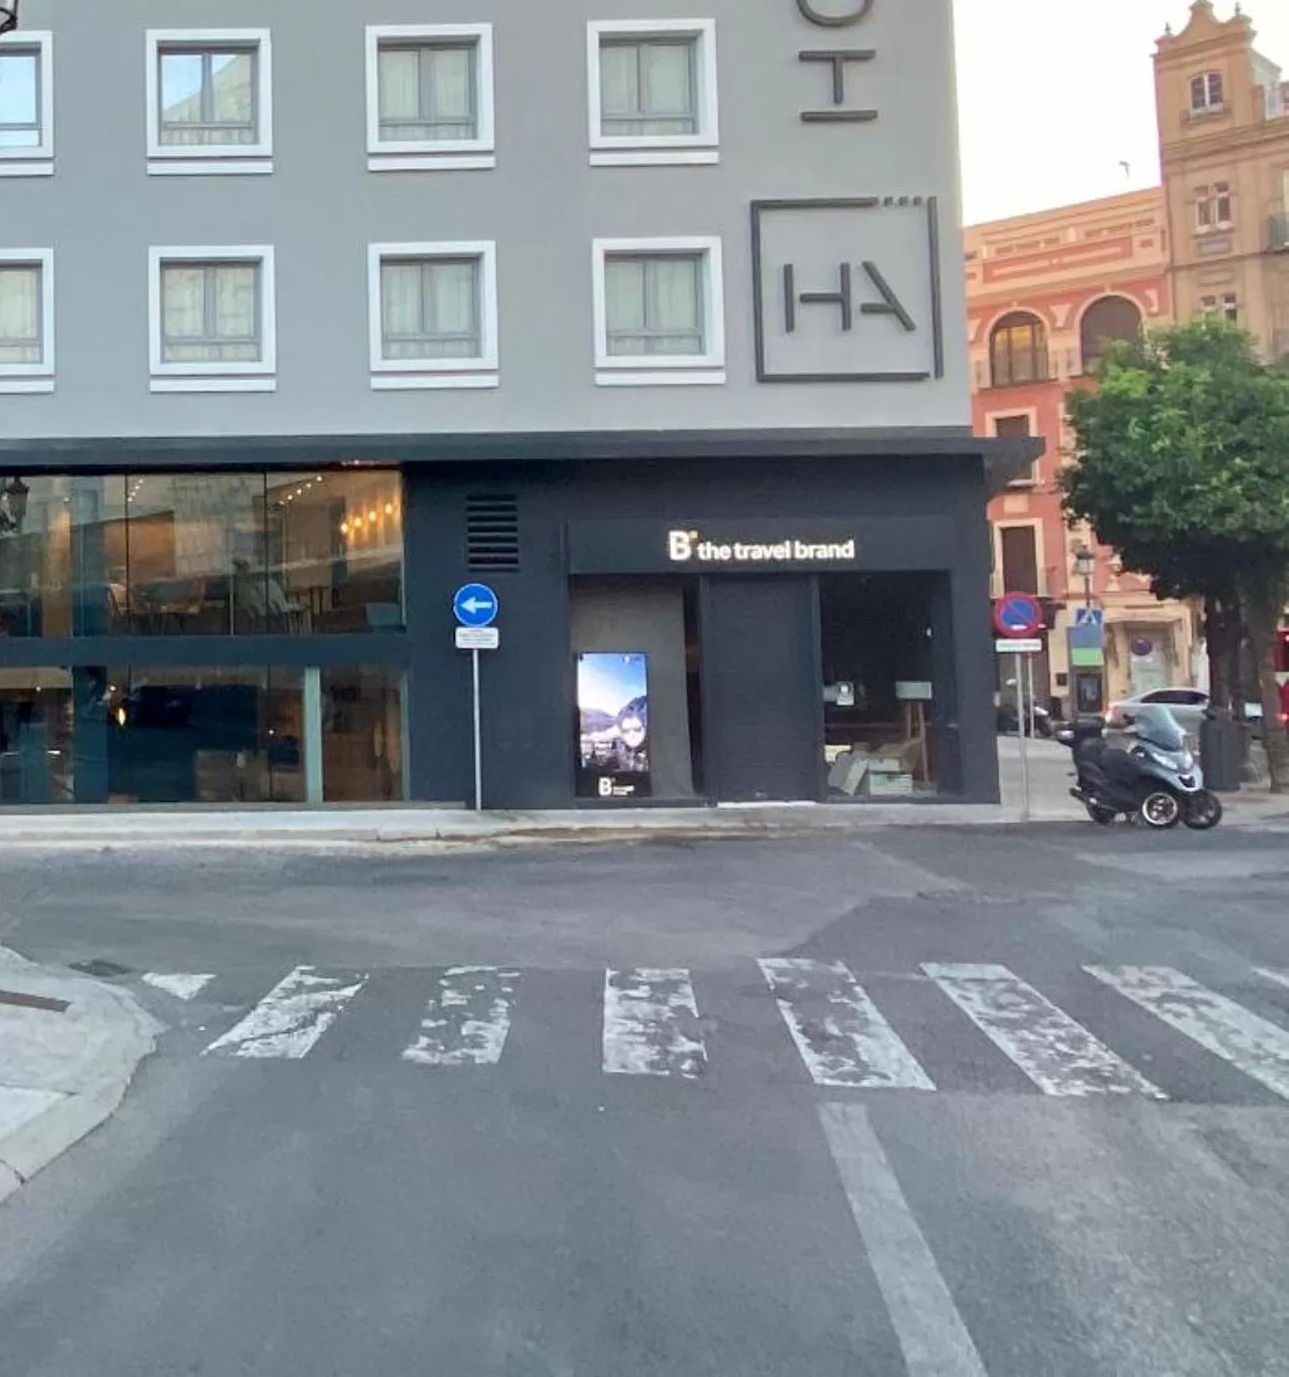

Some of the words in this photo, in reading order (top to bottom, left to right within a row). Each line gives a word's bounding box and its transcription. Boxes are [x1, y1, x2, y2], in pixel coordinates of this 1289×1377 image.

[697, 540, 732, 561] the
[733, 539, 792, 560] travel
[794, 539, 856, 560] brand
